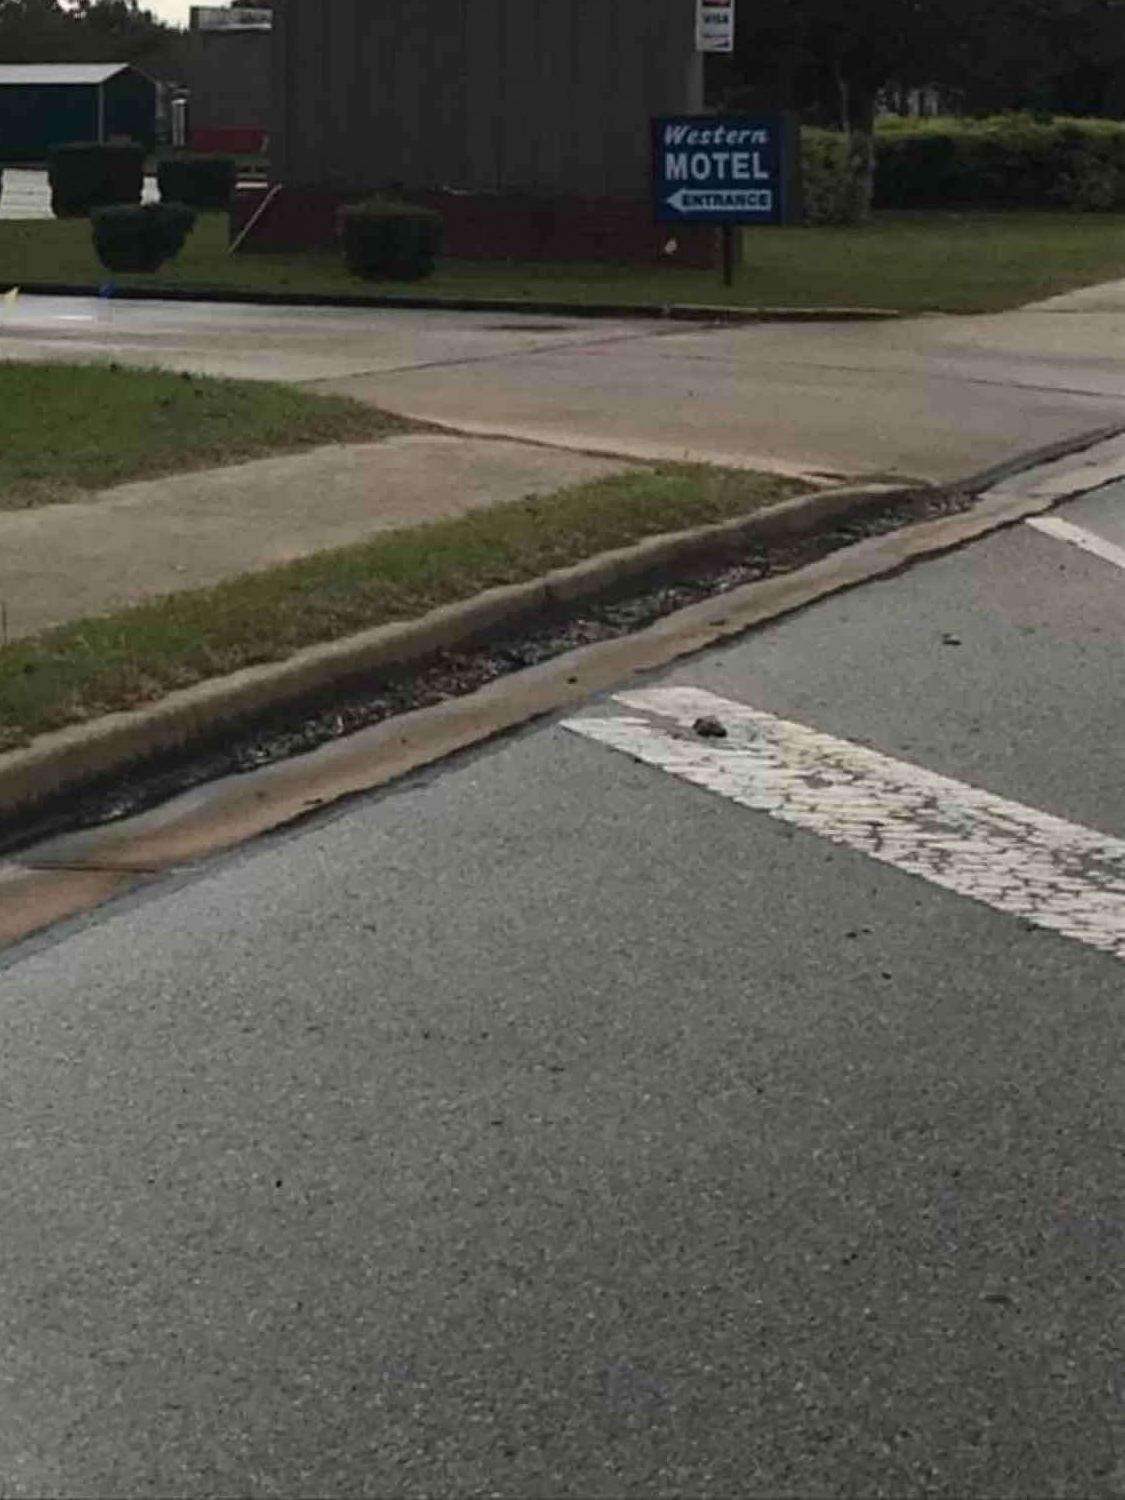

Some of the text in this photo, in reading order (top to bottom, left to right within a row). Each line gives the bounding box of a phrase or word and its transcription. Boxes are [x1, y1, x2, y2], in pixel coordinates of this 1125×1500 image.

[663, 124, 769, 146] Western
[665, 152, 769, 180] MOTEL
[682, 193, 768, 206] ENTRANCE
